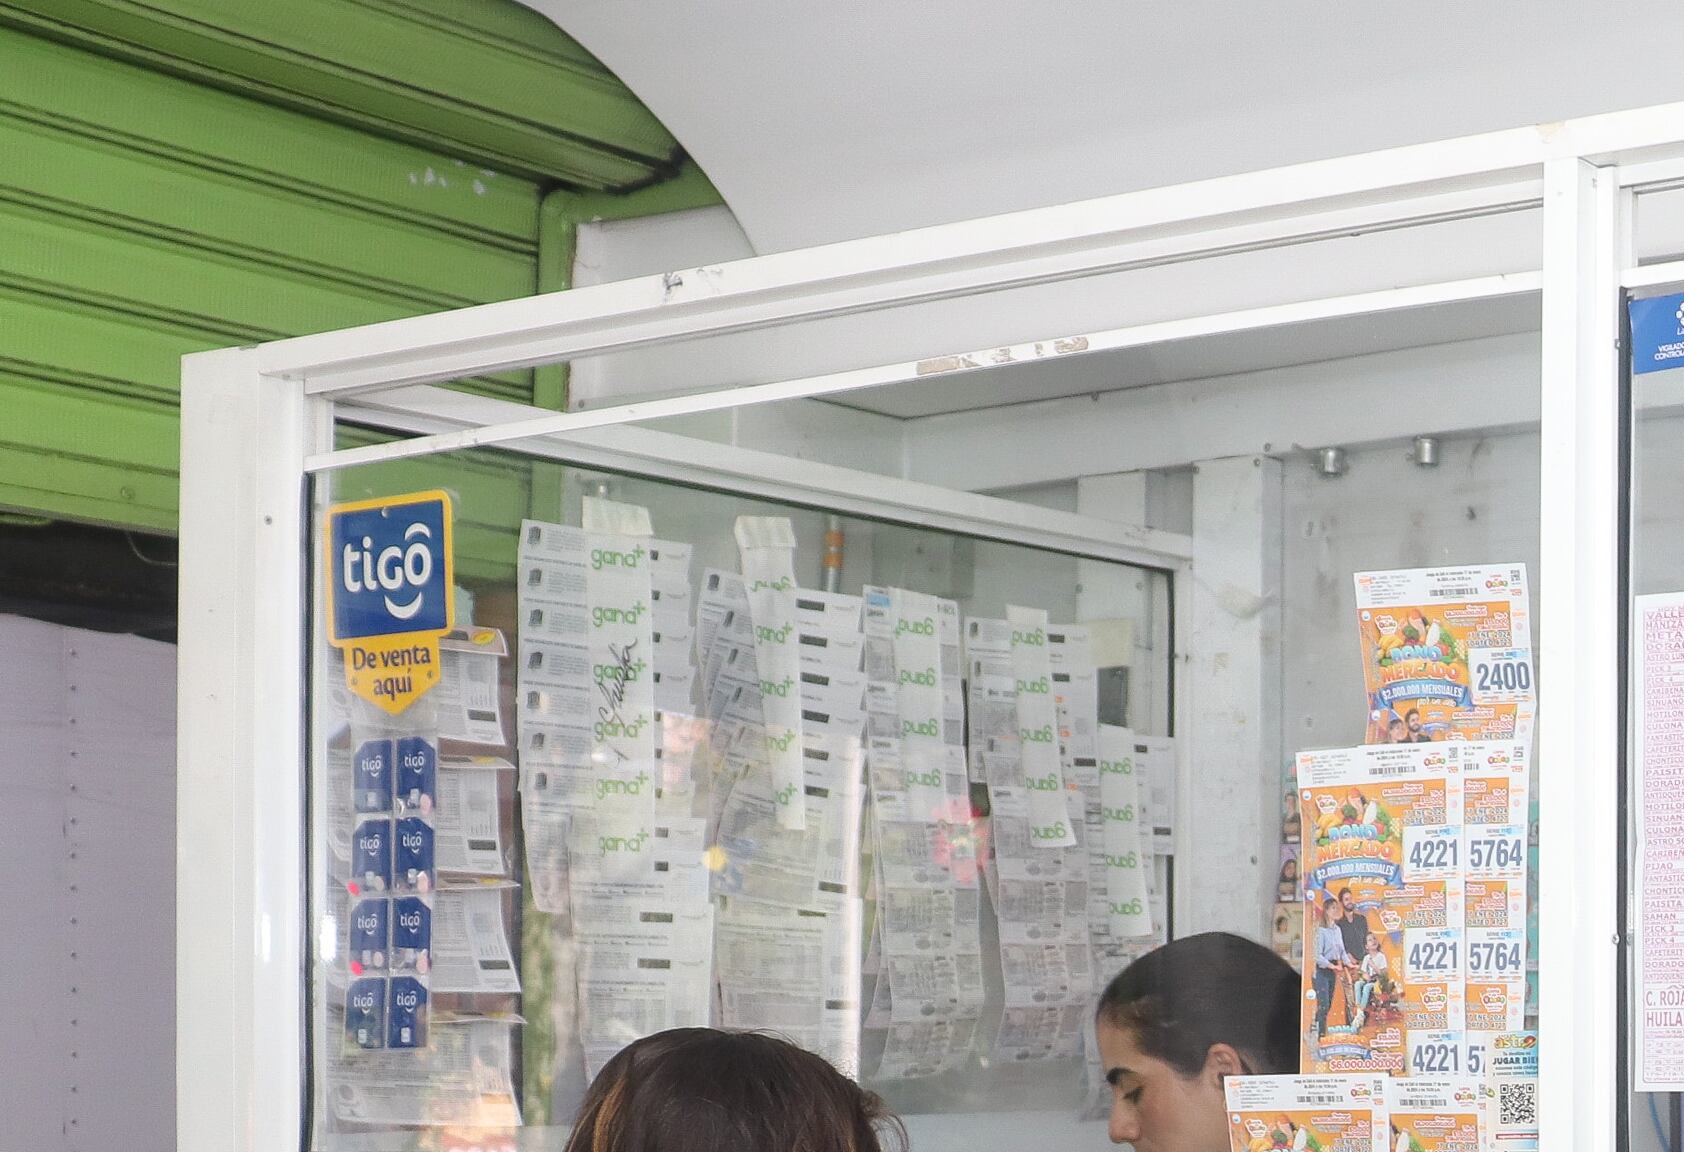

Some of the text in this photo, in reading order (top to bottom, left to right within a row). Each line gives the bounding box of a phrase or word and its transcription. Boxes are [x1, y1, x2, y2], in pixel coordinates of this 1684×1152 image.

[352, 646, 430, 670] De venta
[373, 670, 412, 701] aquí
[1477, 662, 1530, 691] 2400
[1409, 839, 1522, 868] 4221 5764
[1409, 942, 1521, 971] 4221 5764
[1645, 993, 1654, 1005] C.
[1646, 1012, 1683, 1026] HUILA
[1412, 1044, 1459, 1073] 4221
